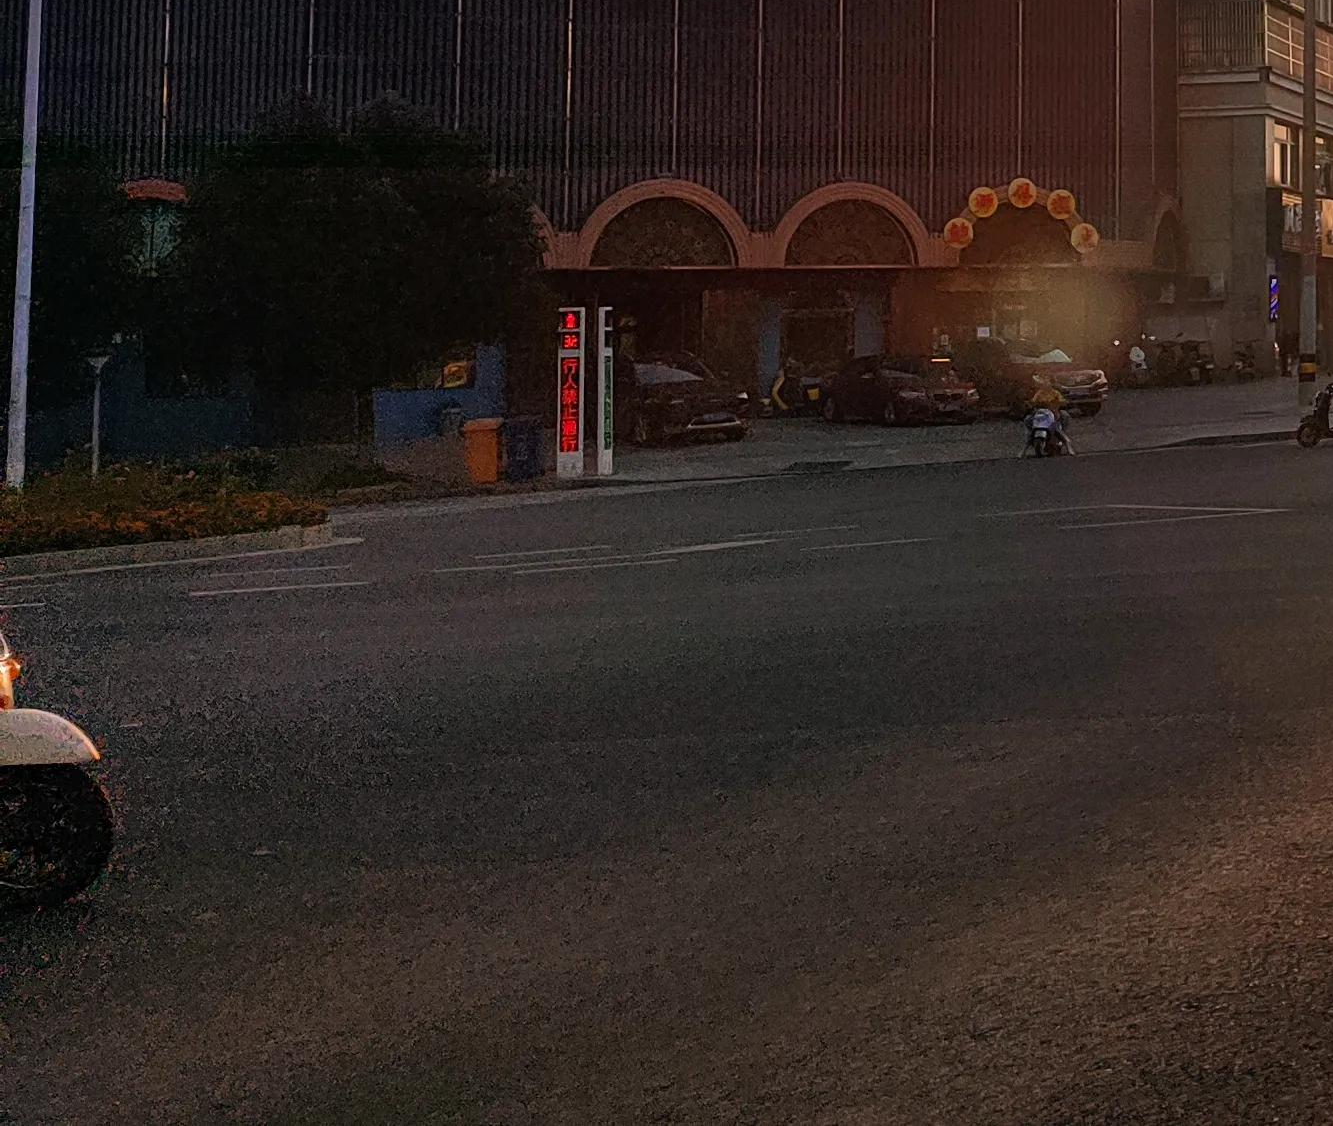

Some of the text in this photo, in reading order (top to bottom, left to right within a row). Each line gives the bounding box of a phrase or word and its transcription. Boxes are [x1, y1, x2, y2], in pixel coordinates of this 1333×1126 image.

[562, 359, 578, 452] 行人禁止通行
